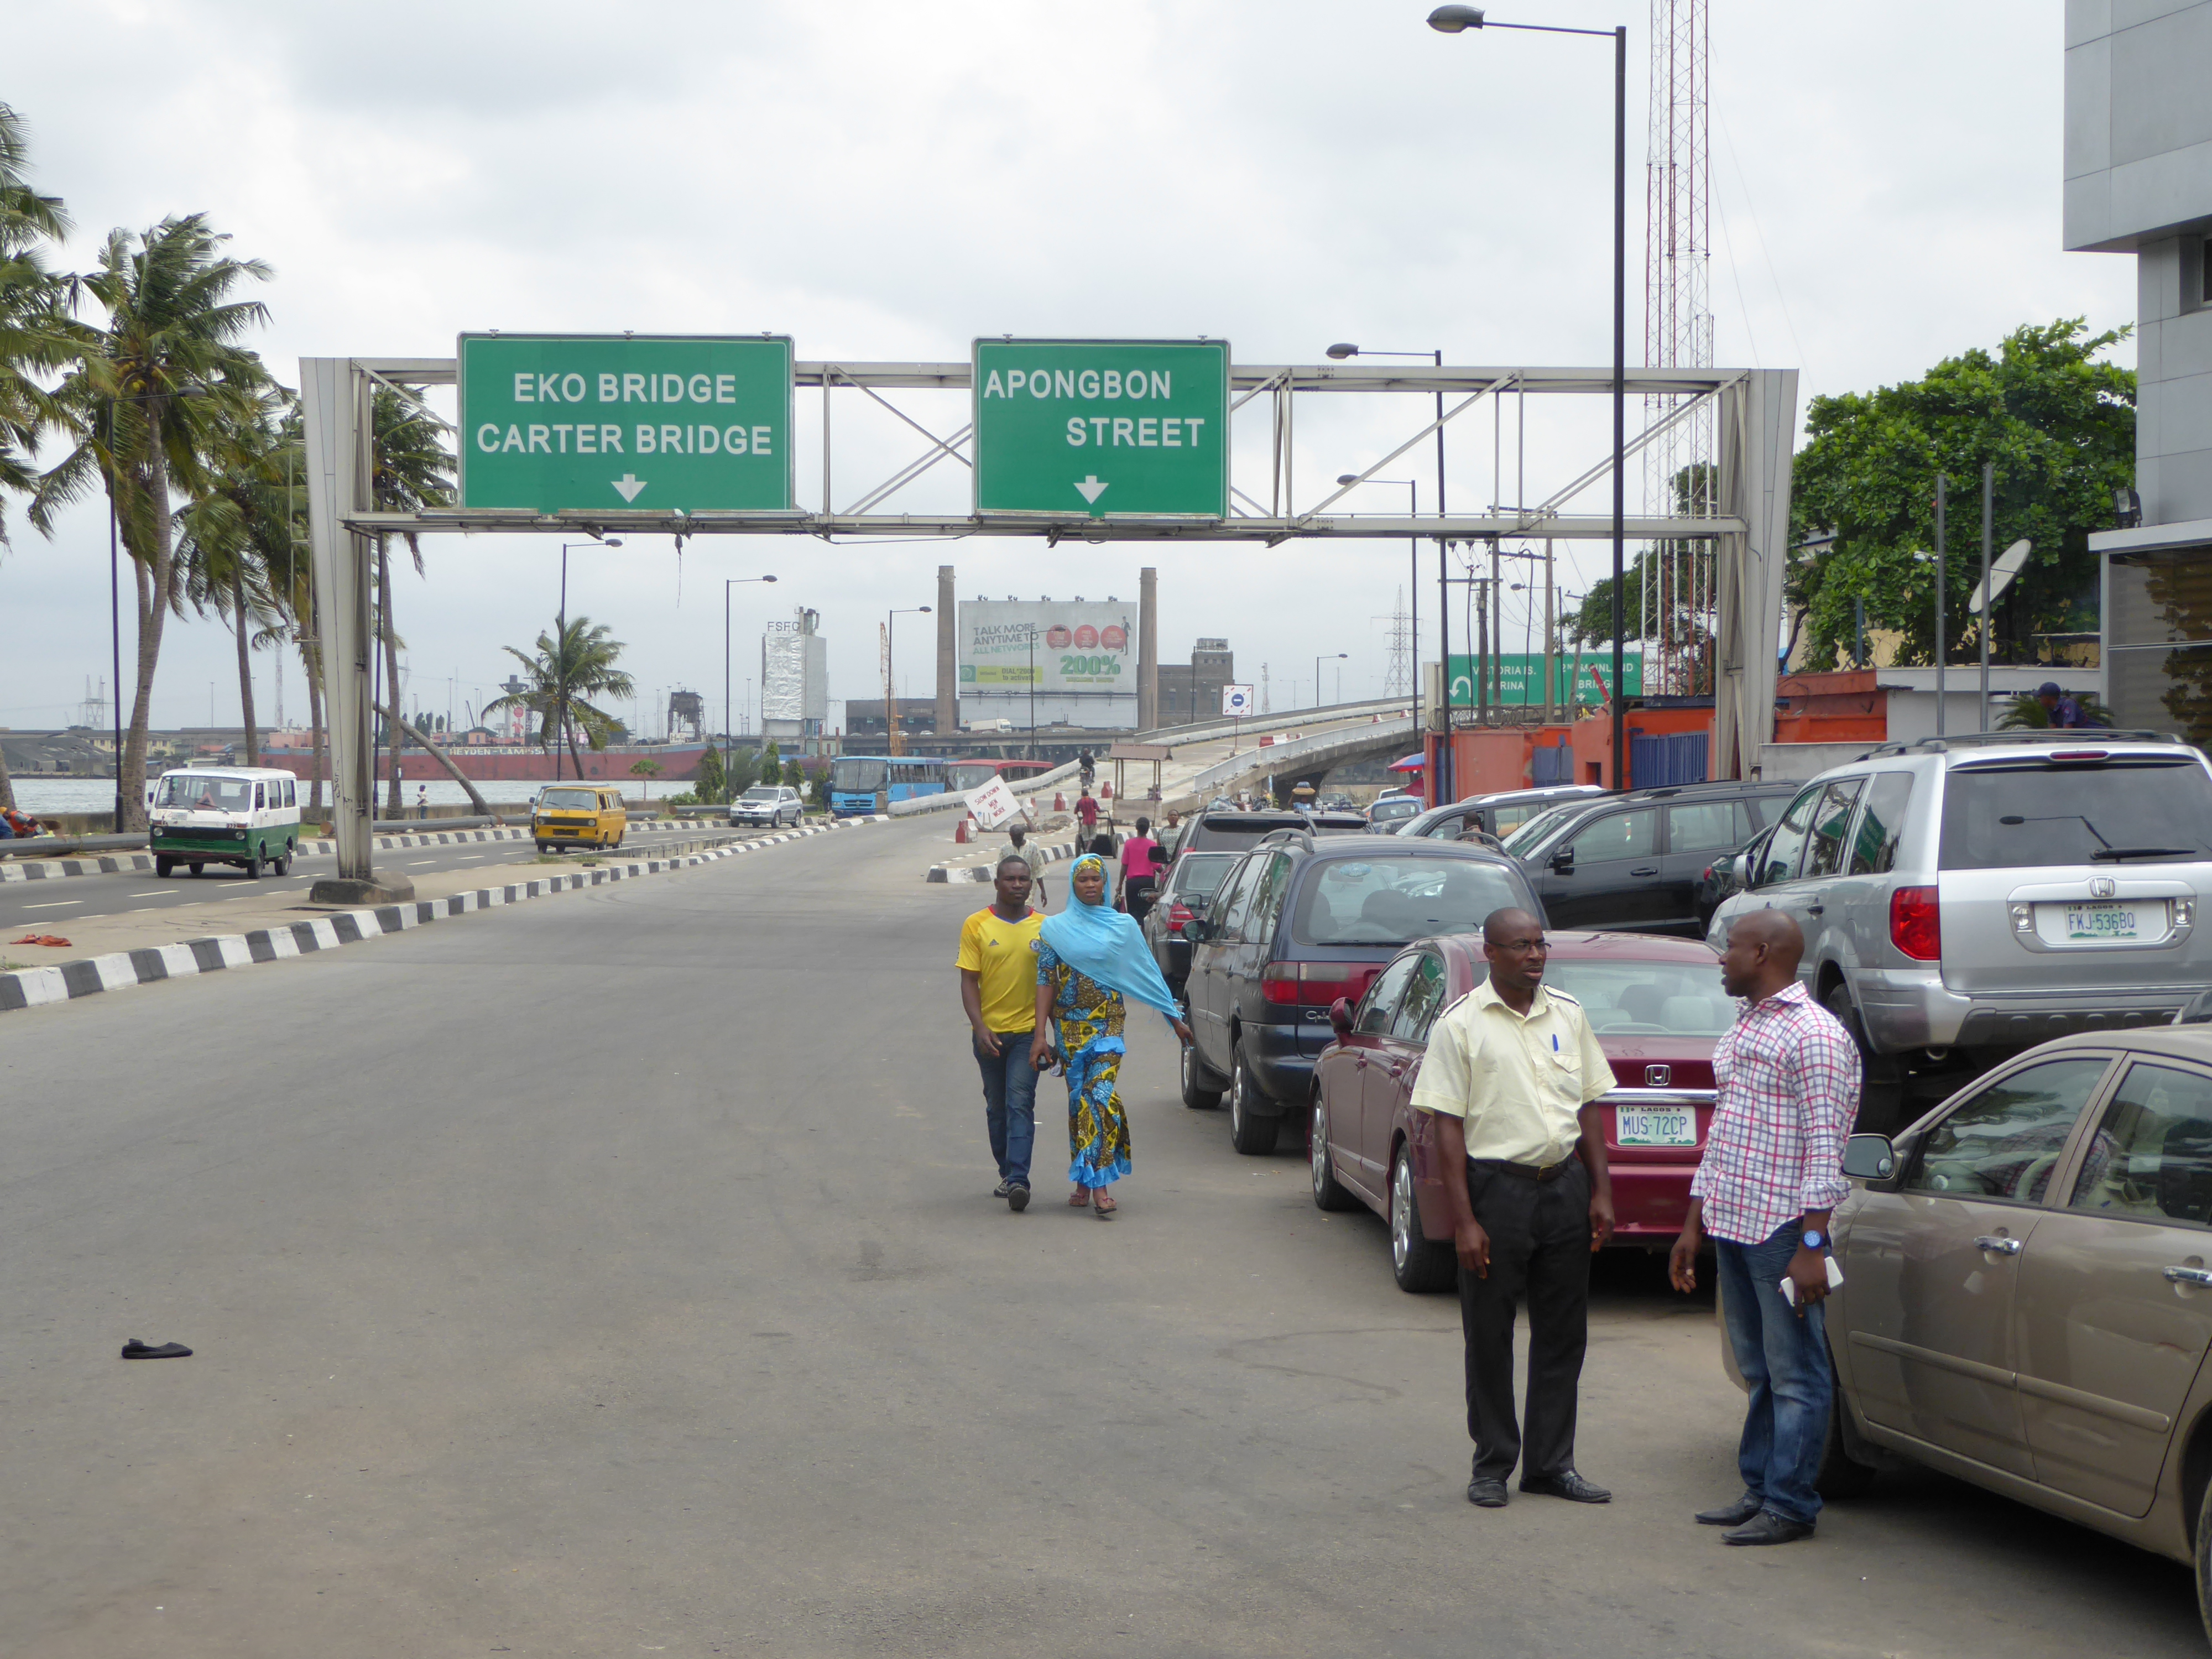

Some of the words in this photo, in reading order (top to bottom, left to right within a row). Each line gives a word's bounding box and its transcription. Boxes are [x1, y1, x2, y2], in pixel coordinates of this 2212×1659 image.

[514, 373, 586, 402] EKO
[598, 374, 736, 403] BRIDGE
[984, 370, 1171, 399] APONGBON
[1066, 418, 1204, 446] STREET
[477, 424, 624, 453] CARTER
[636, 425, 771, 455] BRIDGE
[973, 625, 1001, 636] TALK
[1004, 623, 1036, 633] MORE
[973, 634, 1022, 645] ANYTIME
[1024, 633, 1039, 641] TO
[991, 643, 1040, 653] NETWORKS
[1060, 655, 1121, 675] 200%
[1473, 666, 1521, 675] VTRIA
[1524, 666, 1536, 675] IS.
[1580, 663, 1633, 672] MINLND
[1486, 681, 1525, 690] MRINA
[1578, 680, 1613, 688] BRIG
[974, 793, 988, 805] SLOW
[986, 785, 1000, 797] DOWN
[988, 798, 998, 807] MEN
[992, 806, 1006, 817] WORK
[1623, 1116, 1687, 1135] MUS-72CP
